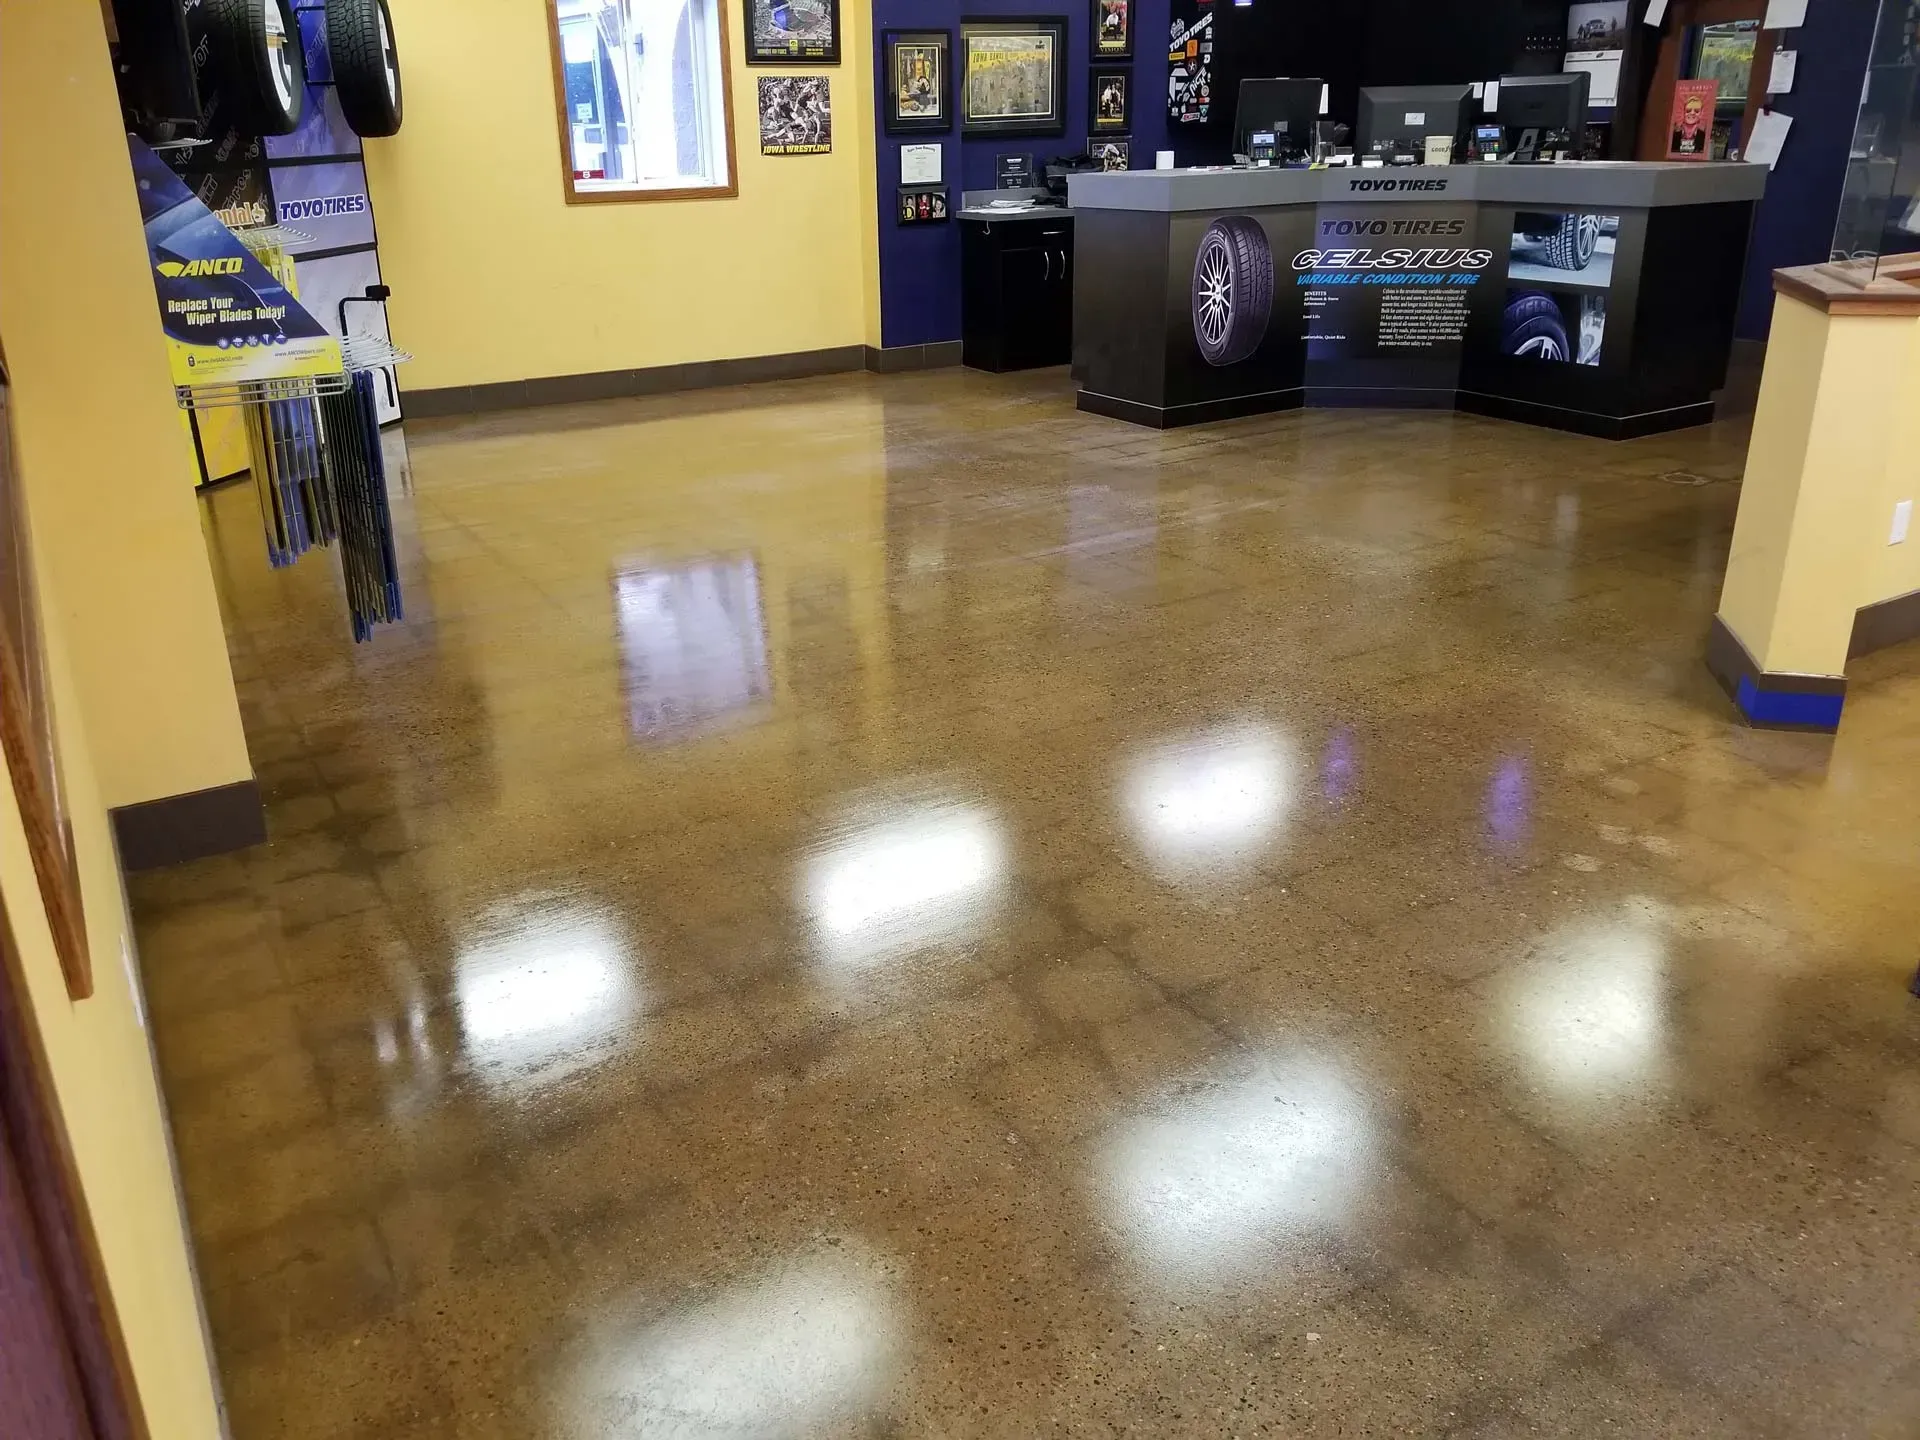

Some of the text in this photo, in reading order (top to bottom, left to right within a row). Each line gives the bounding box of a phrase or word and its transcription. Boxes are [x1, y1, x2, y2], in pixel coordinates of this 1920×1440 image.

[1169, 12, 1213, 52] TOYO TIRES
[763, 144, 831, 154] IOWA WRESTLING
[1349, 180, 1448, 191] TOYO TIRES
[280, 194, 366, 222] TOYO TIRES
[1321, 219, 1466, 236] TOYO TIRES
[180, 257, 243, 277] ANCO
[1291, 248, 1493, 270] CELSIUS
[1296, 274, 1481, 286] VARIABLE CONDITION TIRE
[167, 297, 234, 314] Replace Your
[186, 305, 286, 326] Wiper Blades Today!
